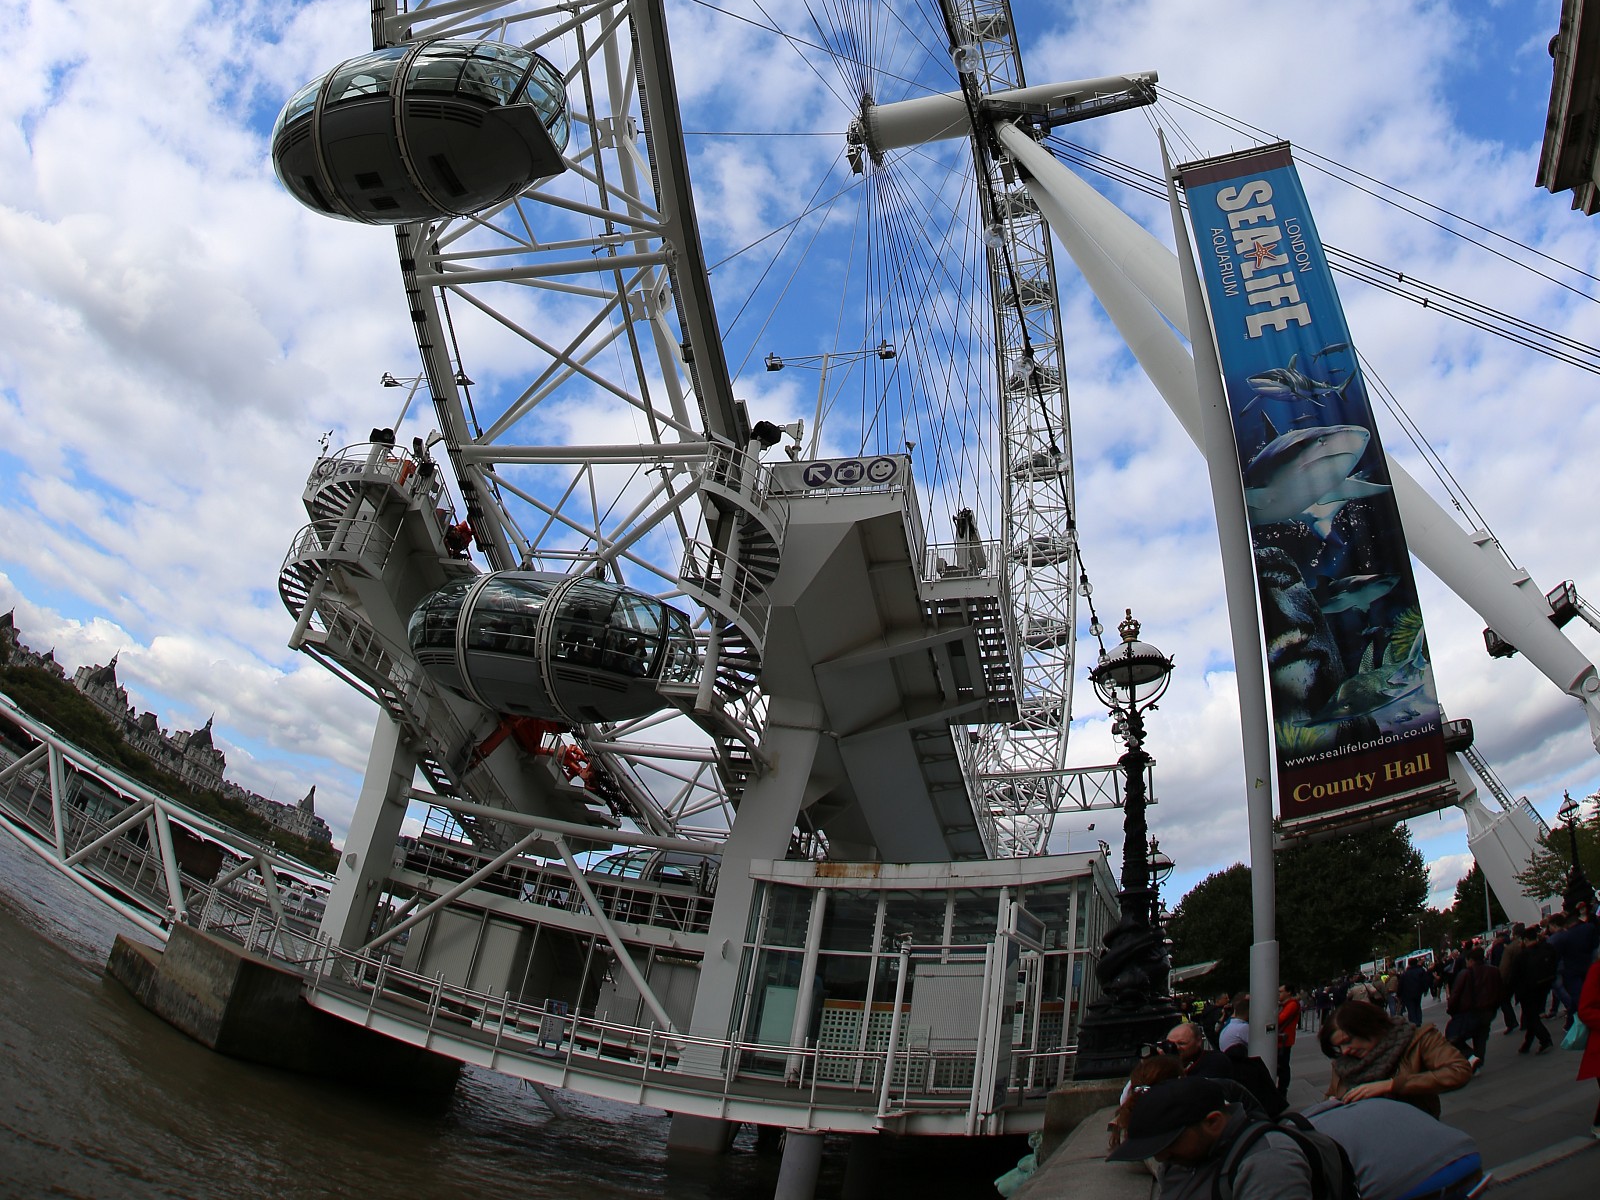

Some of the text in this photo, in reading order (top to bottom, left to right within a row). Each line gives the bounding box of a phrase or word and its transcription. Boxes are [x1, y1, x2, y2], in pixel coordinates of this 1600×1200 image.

[1216, 179, 1282, 255] SEA
[1284, 217, 1312, 273] LONDON
[1210, 227, 1239, 297] AQUARIUM
[1285, 723, 1435, 768] www.sealifelondon.co.uk
[1293, 753, 1431, 801] County Hall
